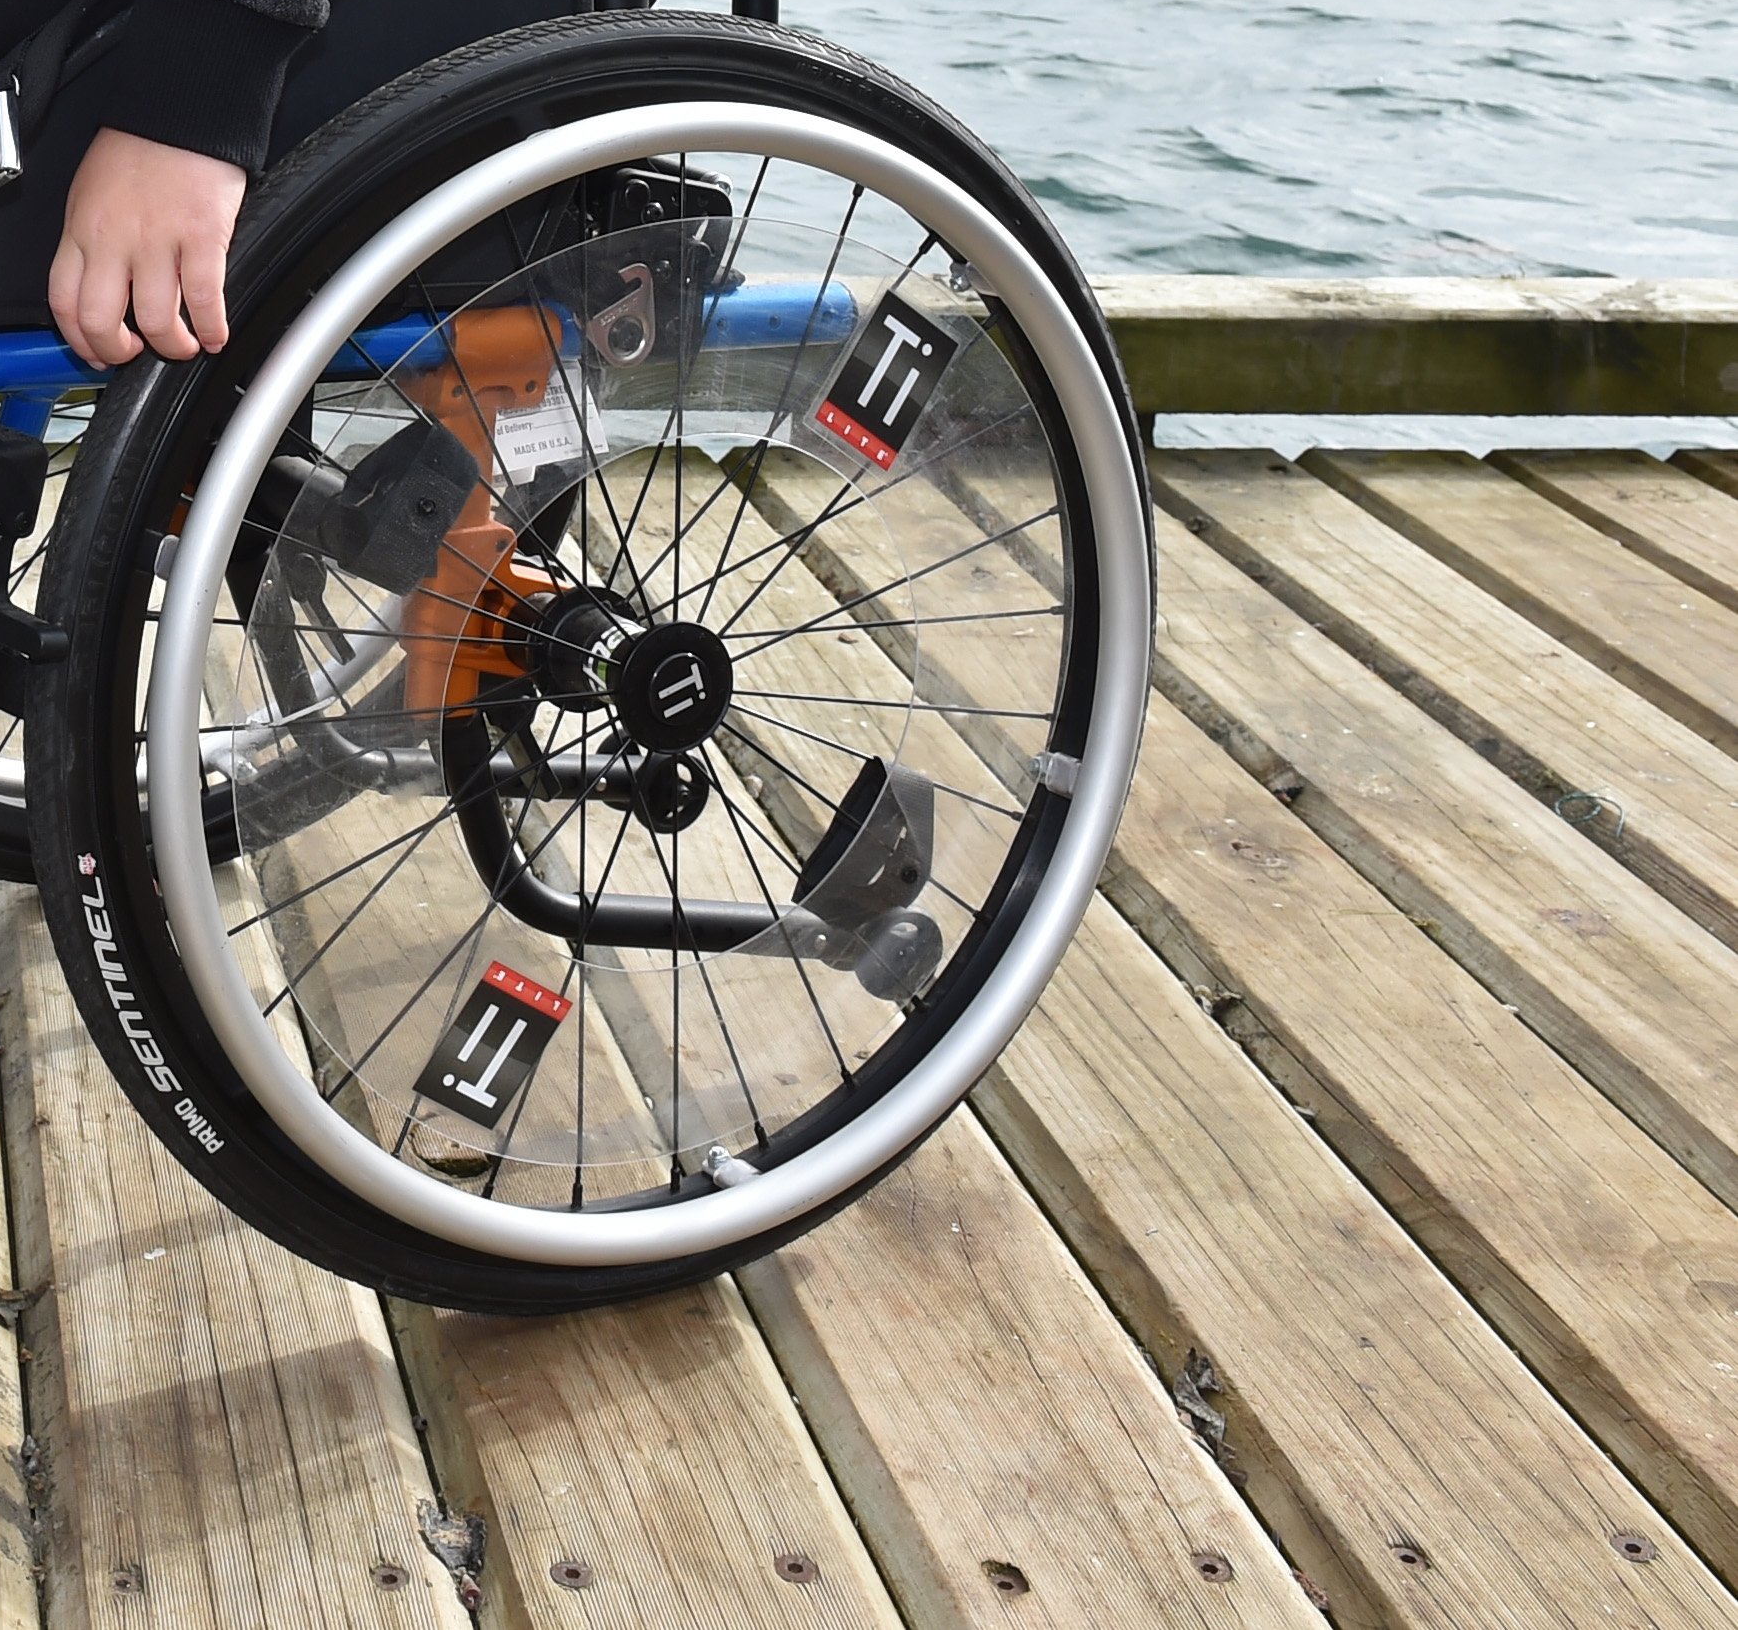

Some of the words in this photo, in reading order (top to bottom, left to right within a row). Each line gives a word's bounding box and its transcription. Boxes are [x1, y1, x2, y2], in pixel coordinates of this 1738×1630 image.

[857, 313, 933, 427] Ti
[513, 442, 537, 456] MADE
[538, 440, 548, 451] IN
[826, 411, 889, 460] LITE
[658, 662, 706, 719] Ti
[81, 876, 183, 1093] SENTINEL
[492, 969, 562, 1012] LITE
[442, 1003, 528, 1109] Ti
